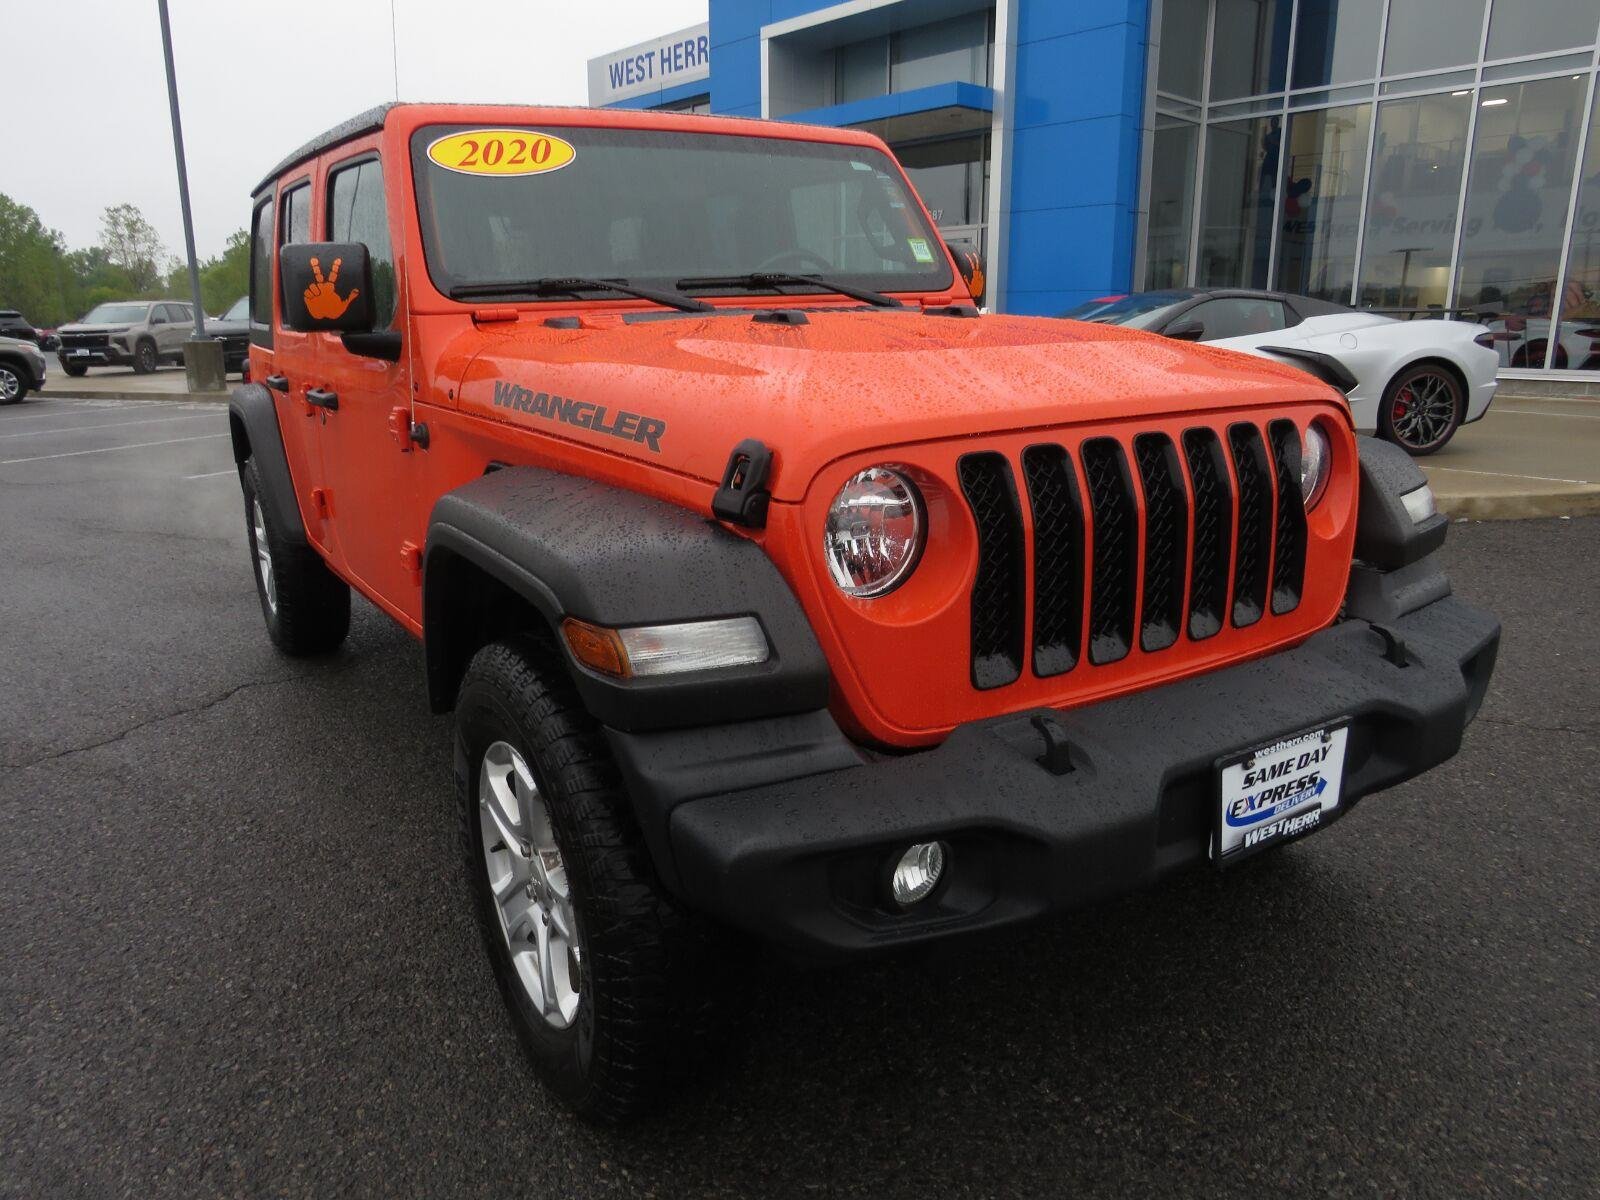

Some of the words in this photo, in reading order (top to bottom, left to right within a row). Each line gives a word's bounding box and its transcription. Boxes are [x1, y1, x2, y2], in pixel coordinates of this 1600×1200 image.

[609, 51, 655, 89] WEST
[660, 36, 709, 75] HERR
[458, 139, 551, 166] 2020
[1391, 214, 1483, 238] Servig
[494, 380, 666, 453] WRANGLER
[1254, 729, 1325, 759] westherr.com
[1242, 757, 1295, 790] SAME
[1296, 744, 1332, 770] DAY
[1231, 771, 1320, 817] EXPRESS
[1274, 787, 1317, 815] DELIVERY
